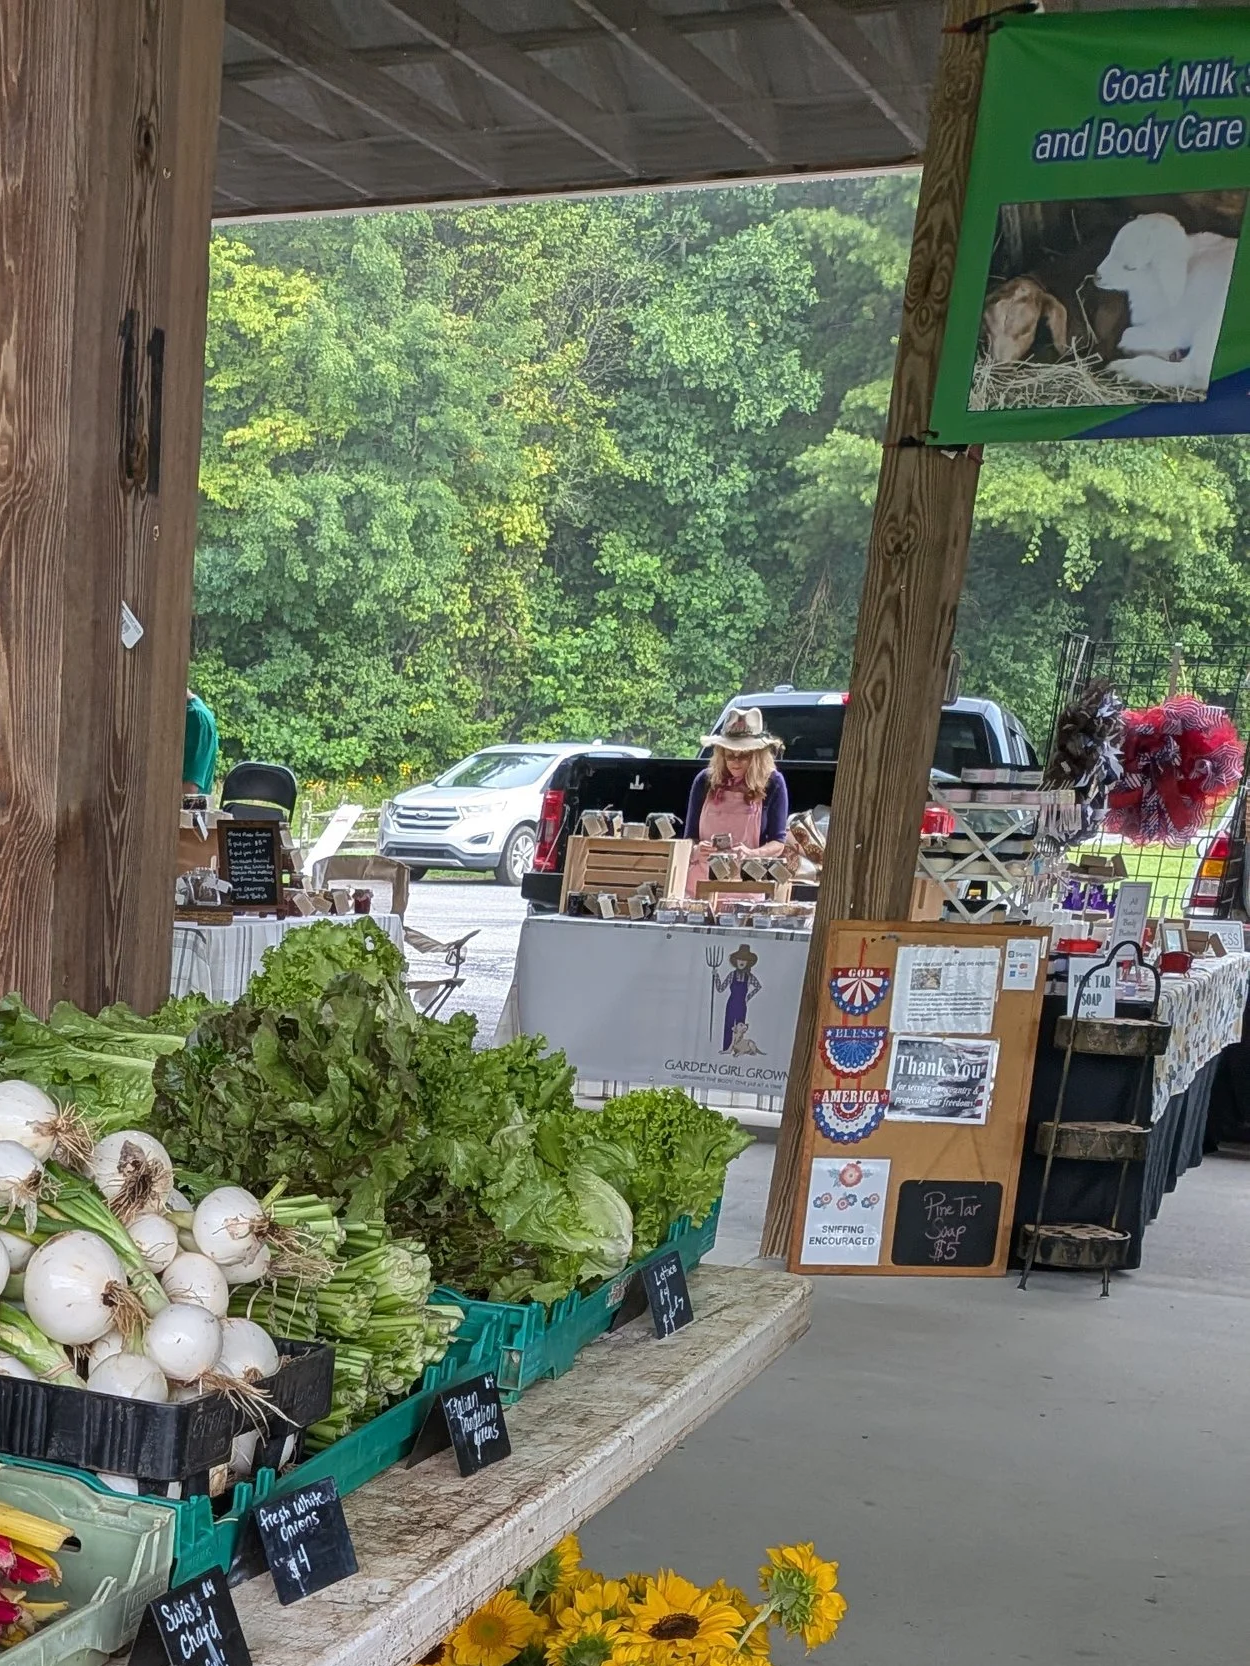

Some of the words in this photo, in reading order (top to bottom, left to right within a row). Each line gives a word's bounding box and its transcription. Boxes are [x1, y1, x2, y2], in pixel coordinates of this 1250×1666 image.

[1102, 65, 1170, 102] Goat
[1177, 63, 1237, 97] Milk
[1035, 123, 1091, 160] and
[1097, 117, 1169, 160] Body
[1177, 114, 1244, 150] Care
[847, 968, 875, 979] GOD
[1095, 974, 1111, 989] TAR
[1081, 992, 1103, 1007] SOAP
[834, 1028, 877, 1039] BLESS
[664, 1059, 718, 1075] GARDEN
[718, 1064, 745, 1078] GIRL
[746, 1067, 790, 1081] GROWN
[896, 1054, 948, 1078] Thank
[949, 1058, 982, 1080] You
[821, 1090, 880, 1104] AMERICA
[907, 1082, 931, 1095] serving
[923, 1191, 955, 1221] Pine
[949, 1195, 982, 1217] Tar
[808, 1235, 875, 1247] ENCOURAGED
[821, 1225, 865, 1235] SNIFFING
[929, 1239, 961, 1263] $5
[445, 1391, 479, 1417] Italian
[287, 1543, 312, 1580] $4
[179, 1605, 223, 1660] Chard
